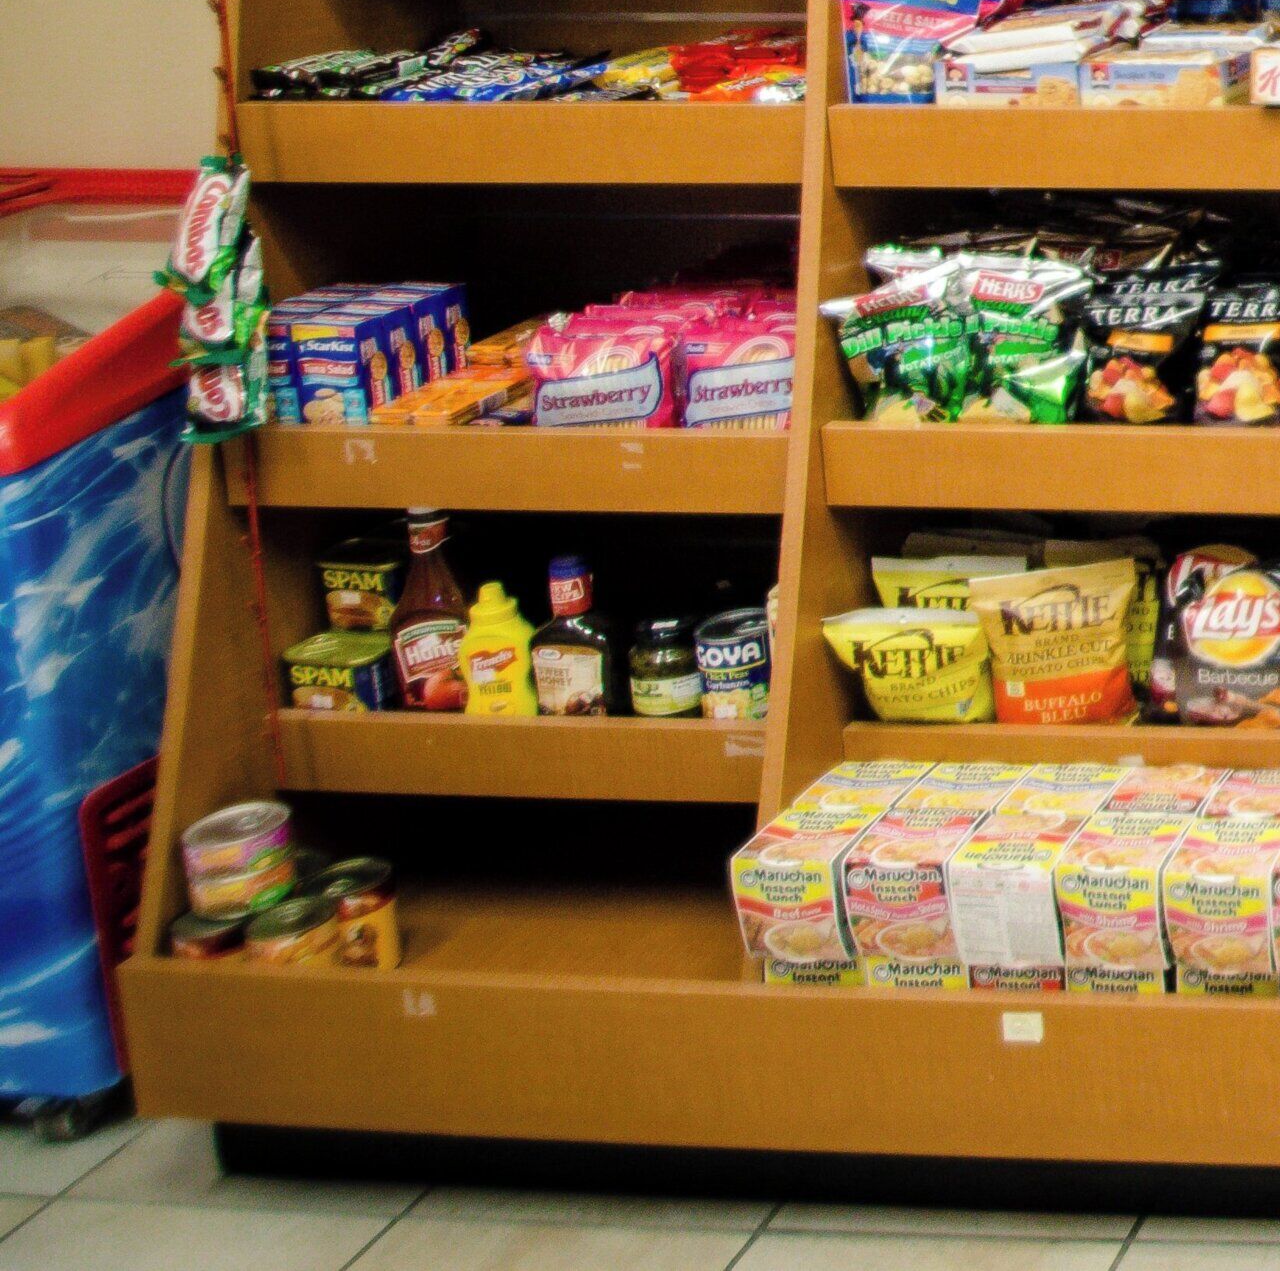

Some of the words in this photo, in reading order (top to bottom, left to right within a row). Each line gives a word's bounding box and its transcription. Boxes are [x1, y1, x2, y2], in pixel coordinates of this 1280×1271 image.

[978, 278, 1038, 301] HERR'S
[1114, 278, 1198, 296] TERRA
[1090, 305, 1177, 325] TERRA
[541, 382, 653, 413] Strawberry
[693, 376, 793, 404] Strawberry
[323, 569, 384, 593] SPAM
[698, 641, 761, 670] GOYA
[290, 664, 353, 689] SPAM
[1198, 668, 1280, 685] Barbecue
[1023, 690, 1103, 714] BUFFALO
[1041, 706, 1089, 725] BLEU
[754, 868, 822, 884] Maruchan
[864, 866, 943, 883] Maruchan
[1077, 874, 1149, 892] Maruchan
[759, 884, 807, 894] Instant
[869, 884, 921, 894] Instant
[1082, 892, 1132, 903] Instant
[1186, 882, 1260, 898] Maruchan
[765, 893, 803, 903] Lunch
[876, 893, 918, 903] Lunch
[1088, 901, 1127, 911] Lunch
[1191, 897, 1242, 908] Instant
[772, 906, 801, 918] Beef
[1196, 907, 1237, 918] Lunch
[888, 963, 961, 977] Maruchan
